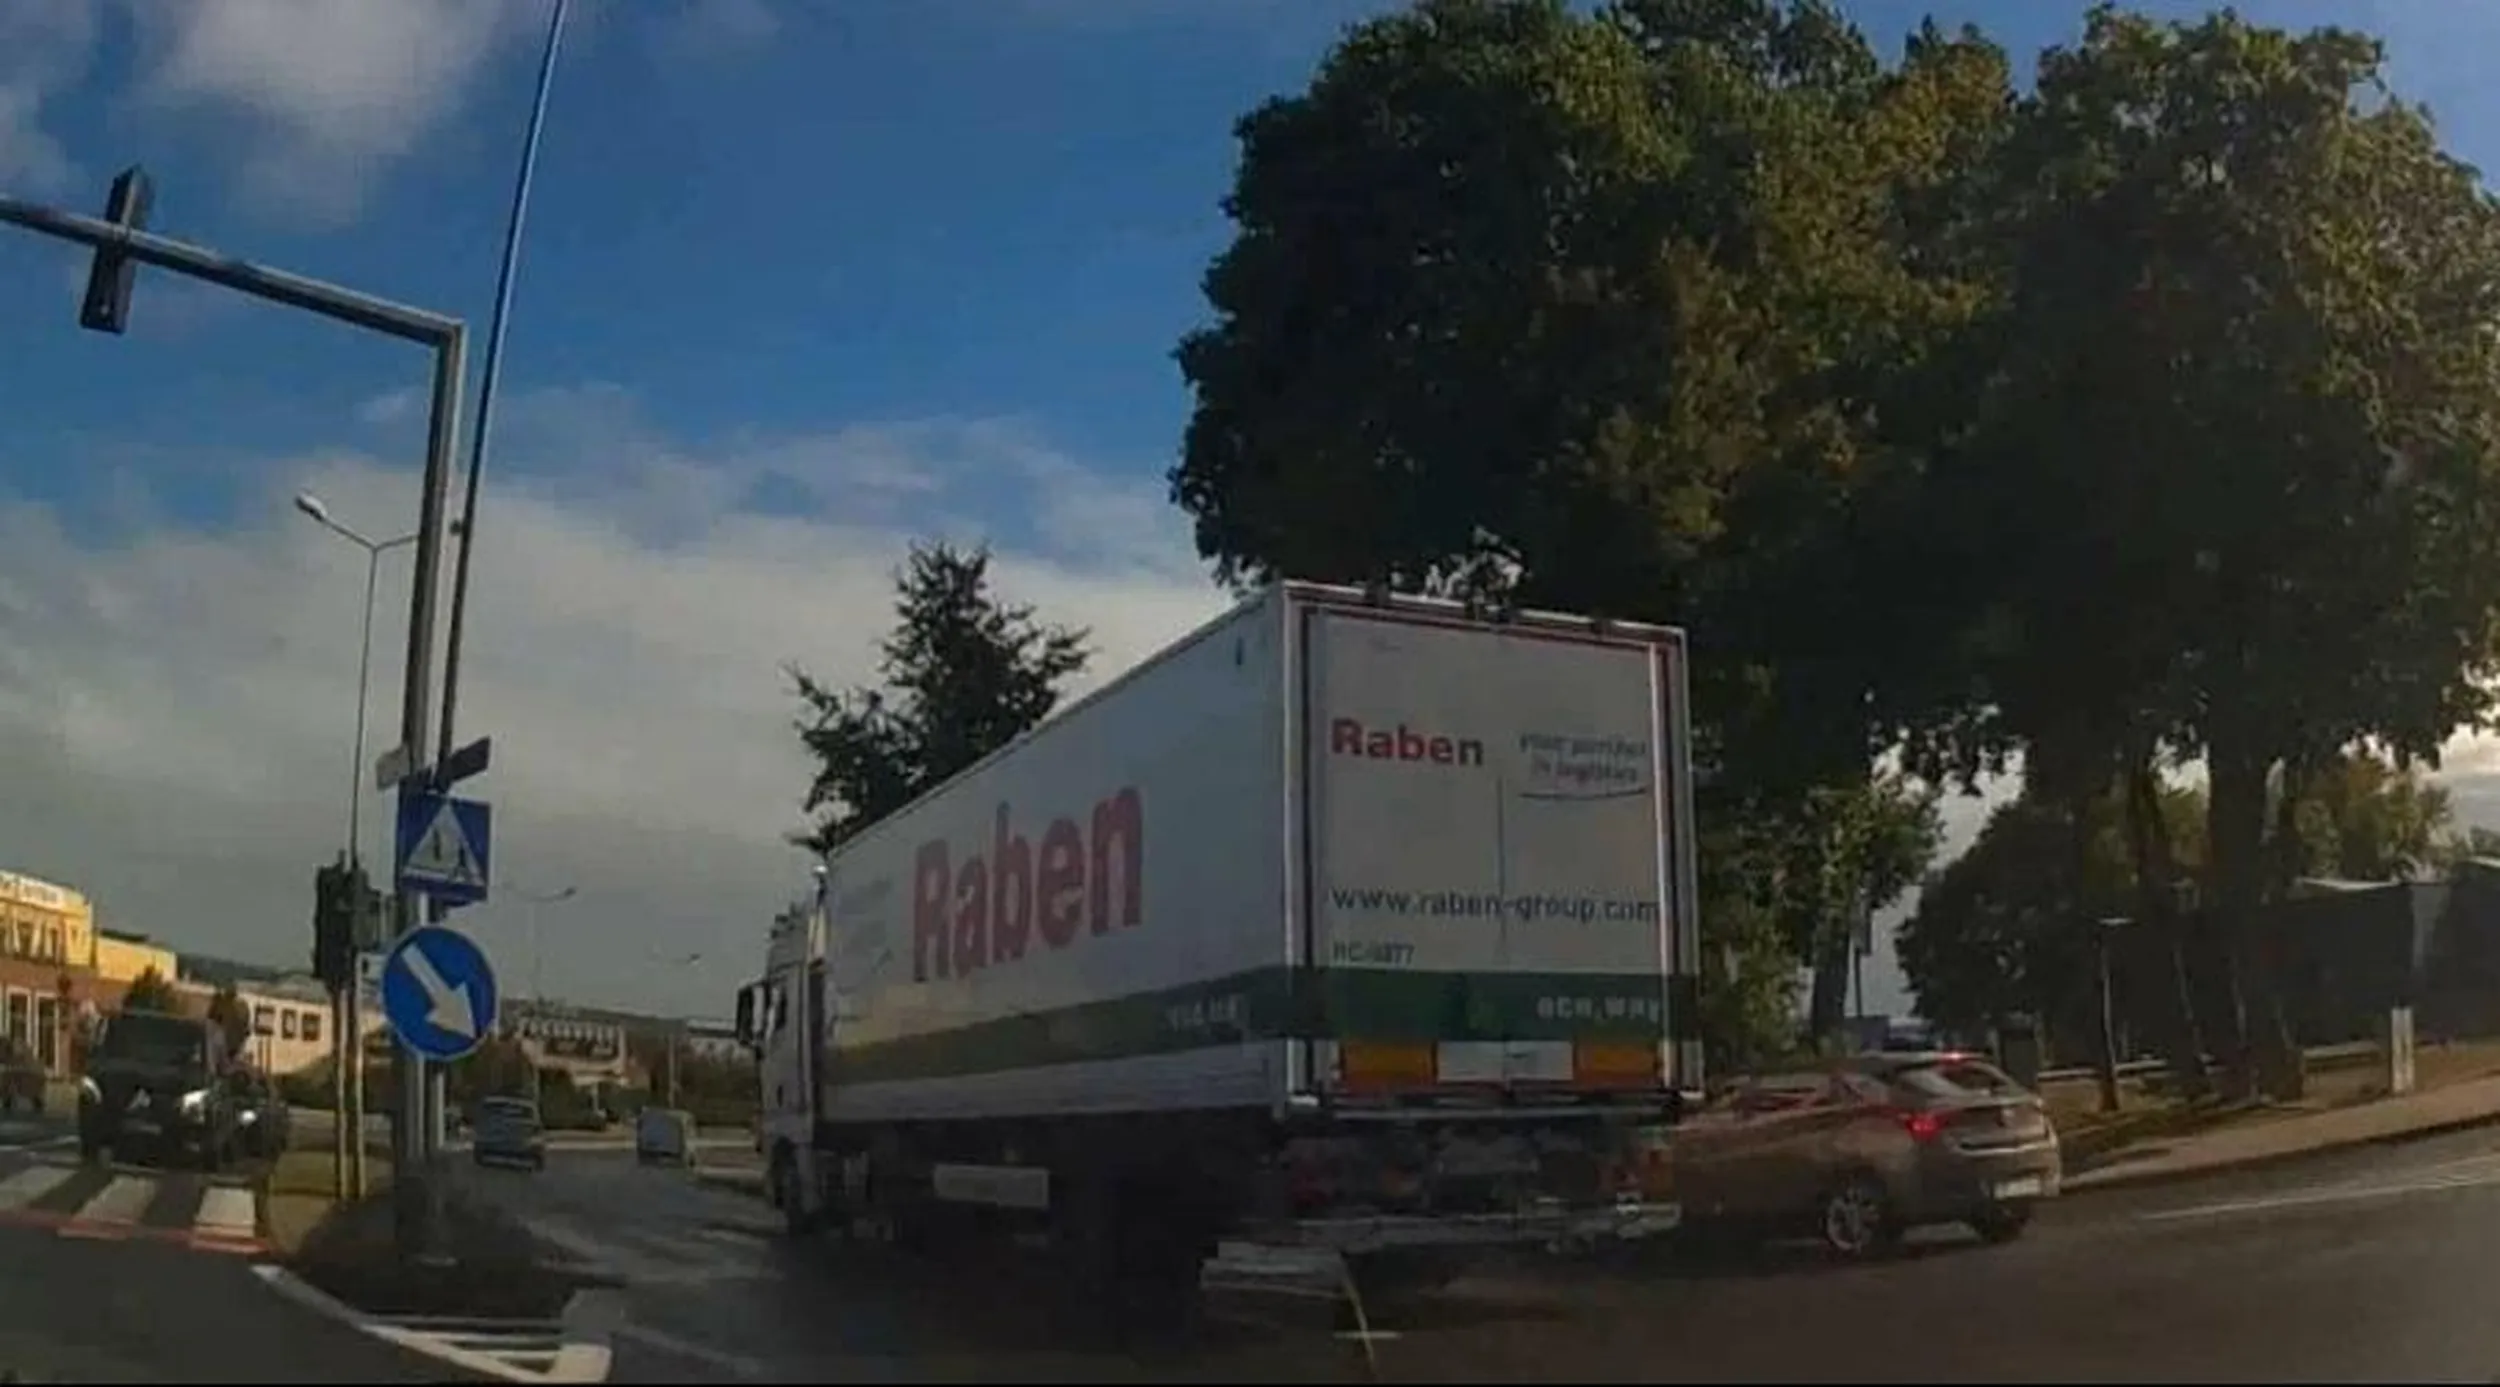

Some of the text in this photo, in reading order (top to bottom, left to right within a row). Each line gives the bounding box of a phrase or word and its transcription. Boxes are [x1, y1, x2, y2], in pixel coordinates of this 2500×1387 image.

[1331, 718, 1484, 766] Raben
[913, 786, 1143, 982] Raben
[1331, 888, 1660, 922] www.raben-group.com
